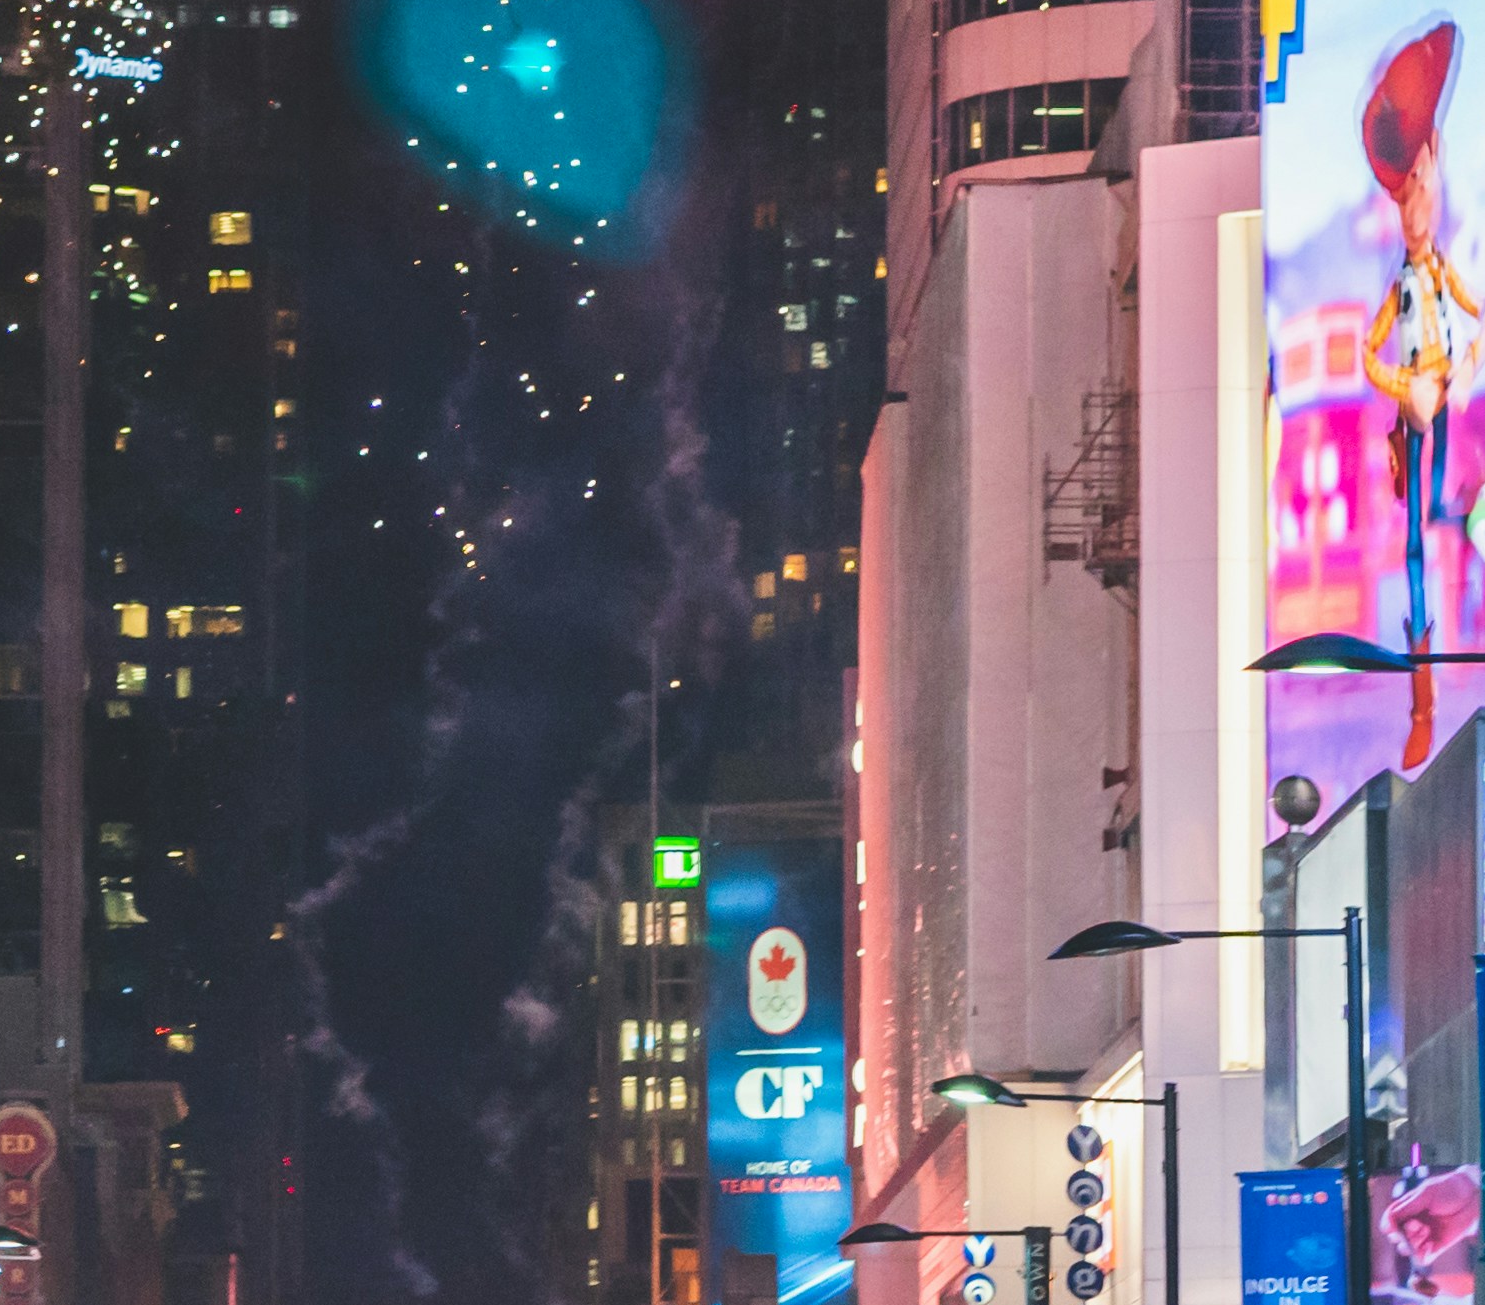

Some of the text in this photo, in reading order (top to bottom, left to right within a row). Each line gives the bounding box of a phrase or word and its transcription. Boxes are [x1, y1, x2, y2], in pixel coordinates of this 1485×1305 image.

[735, 1065, 823, 1119] CF
[745, 1160, 813, 1176] HOME OF
[720, 1176, 841, 1194] TEAM CANADA
[1244, 1276, 1329, 1295] INDULGE
